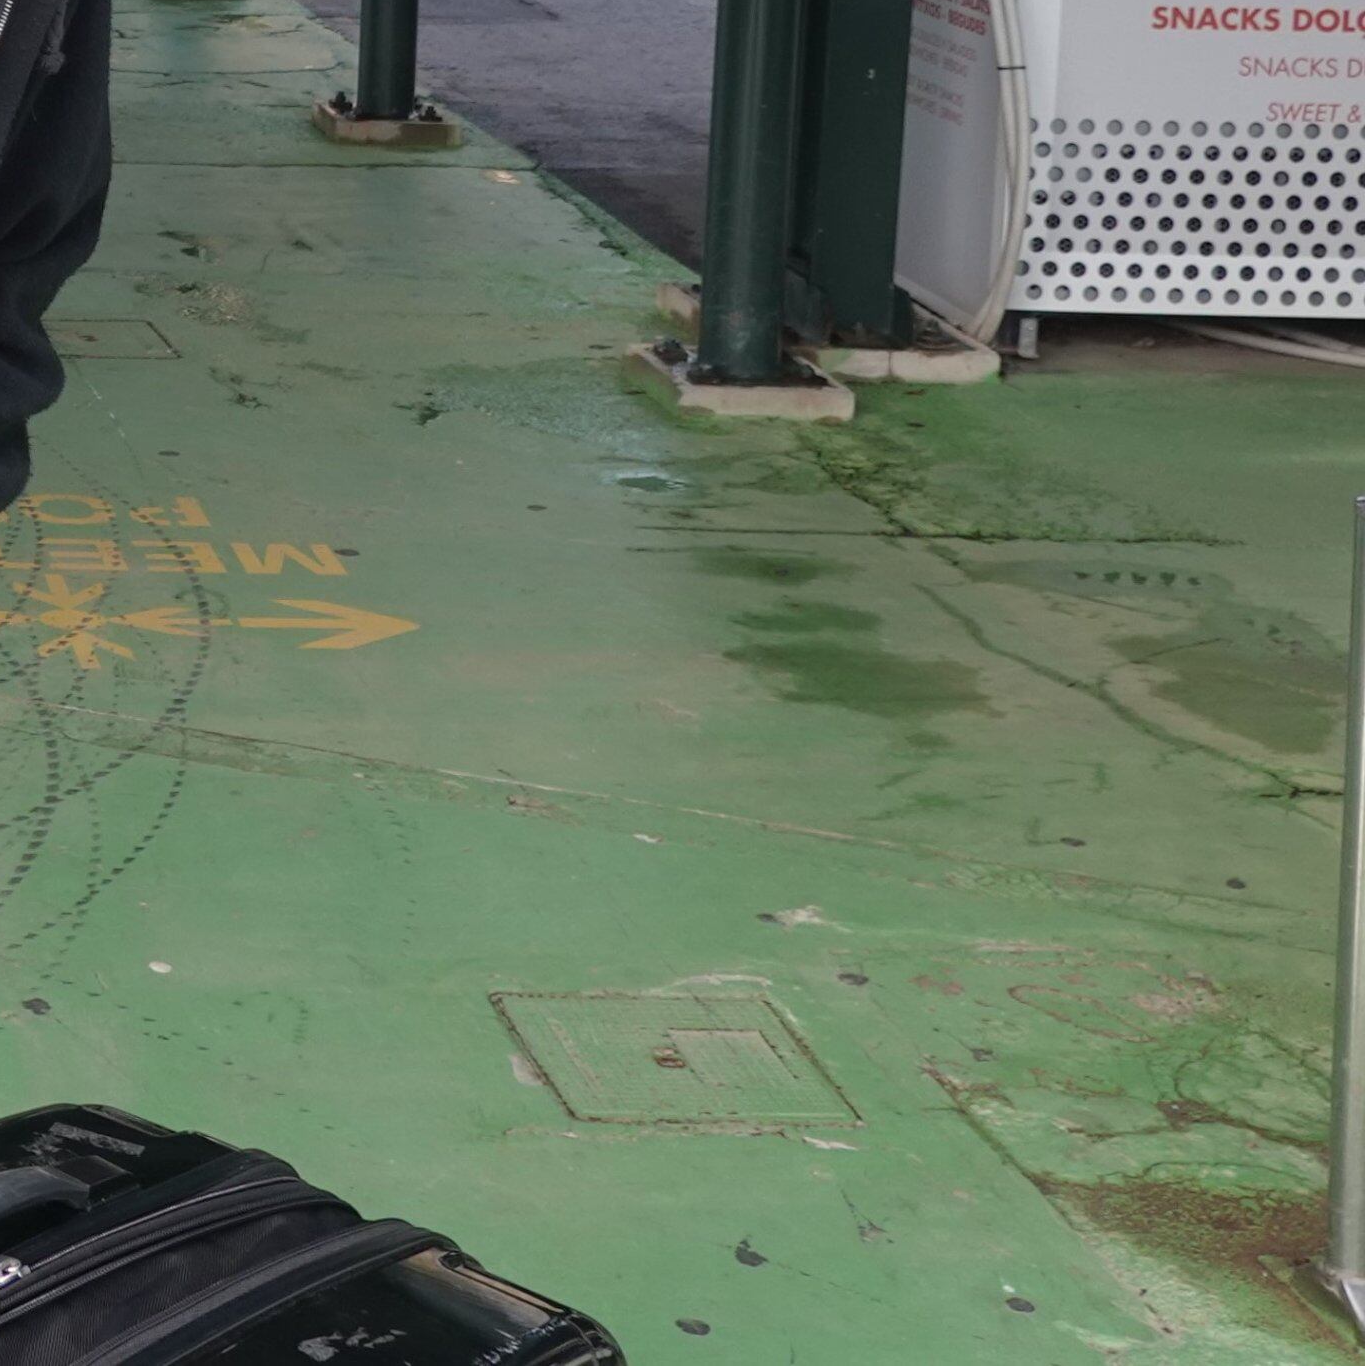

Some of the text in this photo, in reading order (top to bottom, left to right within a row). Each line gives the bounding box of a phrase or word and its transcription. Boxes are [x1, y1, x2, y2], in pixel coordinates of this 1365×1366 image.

[1151, 6, 1281, 31] SNACKS
[1239, 56, 1365, 78] SNACKS D
[1266, 102, 1362, 124] SWEET &
